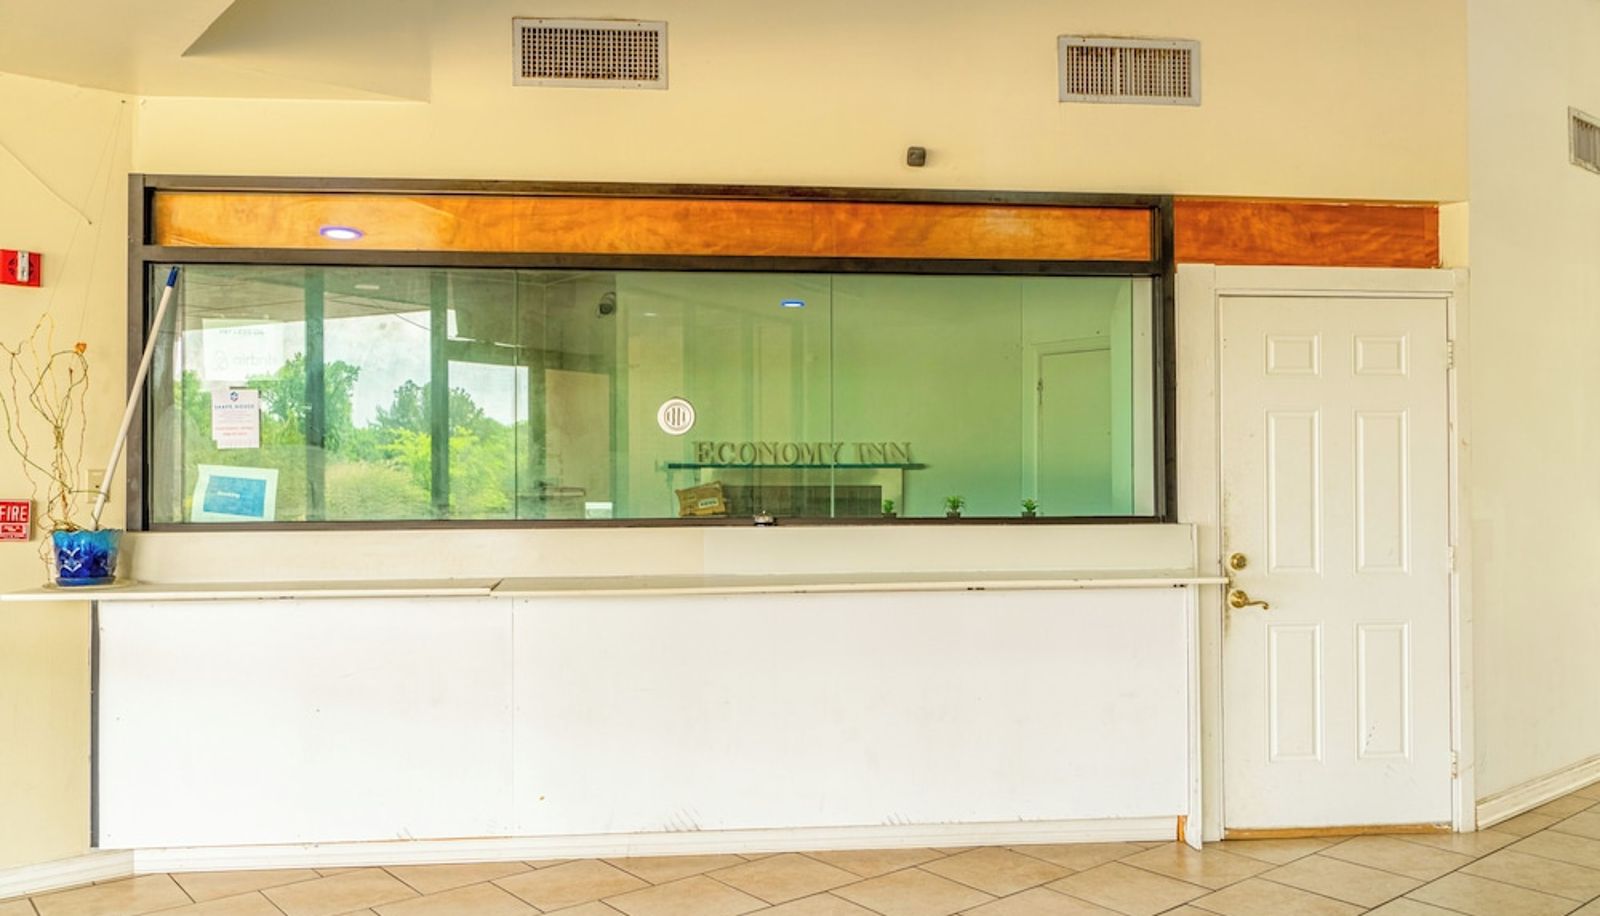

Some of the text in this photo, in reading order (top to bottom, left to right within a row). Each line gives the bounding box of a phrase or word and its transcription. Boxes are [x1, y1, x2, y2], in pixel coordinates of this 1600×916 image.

[692, 441, 912, 465] ECONOMY INN
[0, 505, 28, 522] FIRE
